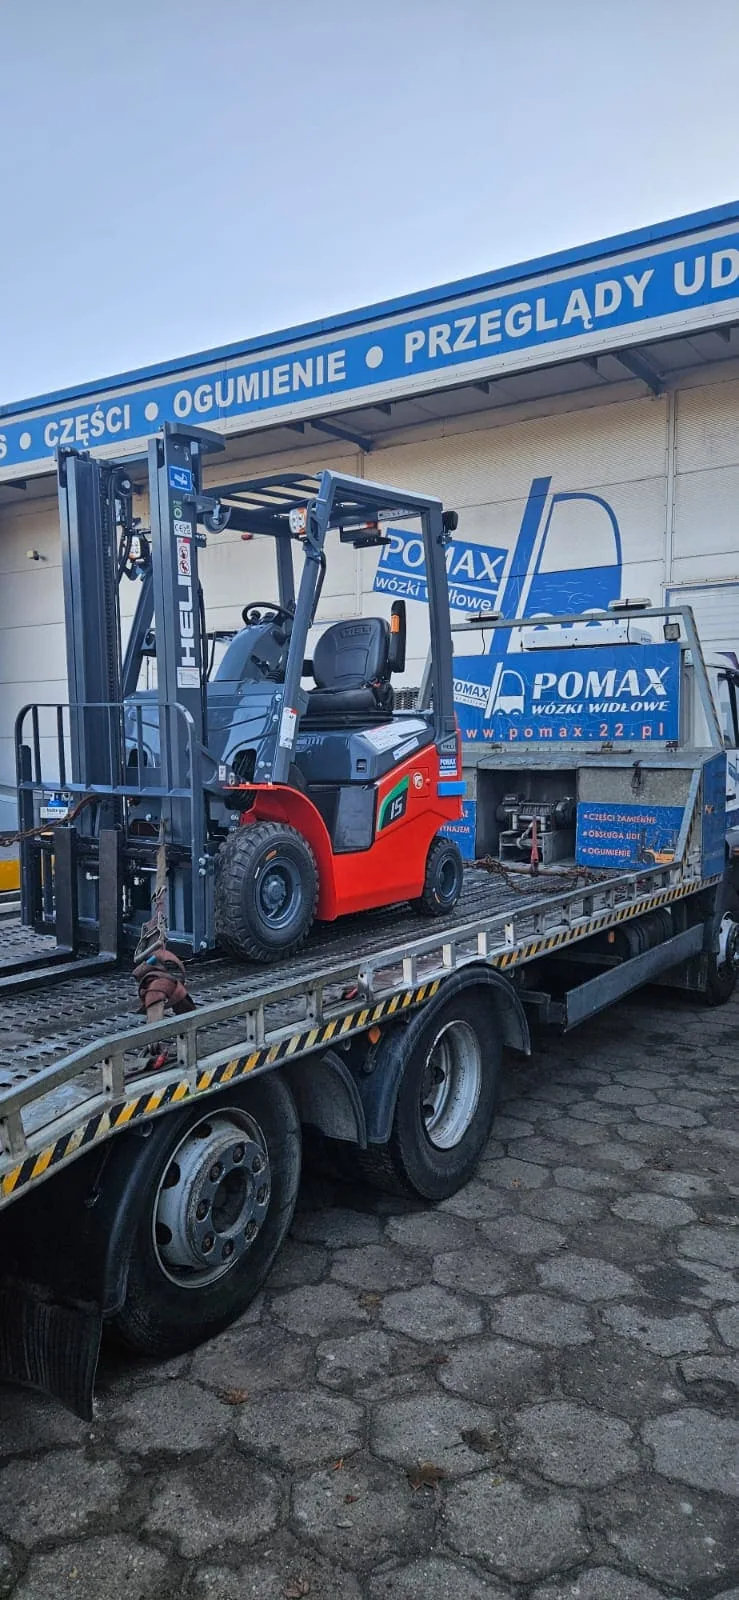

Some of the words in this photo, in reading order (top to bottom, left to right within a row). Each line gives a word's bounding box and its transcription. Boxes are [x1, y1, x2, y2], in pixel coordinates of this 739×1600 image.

[44, 404, 130, 447] CZĘŚCI
[173, 349, 346, 418] OGUMIENIE
[404, 269, 655, 363] PRZEGLĄDY
[375, 576, 420, 596] wózki
[177, 575, 196, 667] HELI
[453, 681, 489, 699] OMAX
[532, 666, 671, 700] POMAX
[532, 701, 583, 714] WÓZKI
[588, 701, 671, 713] WIDŁOWE
[466, 722, 664, 741] ww.pomax.22.pl
[390, 795, 403, 820] 15
[588, 847, 631, 858] OGUMIENIE
